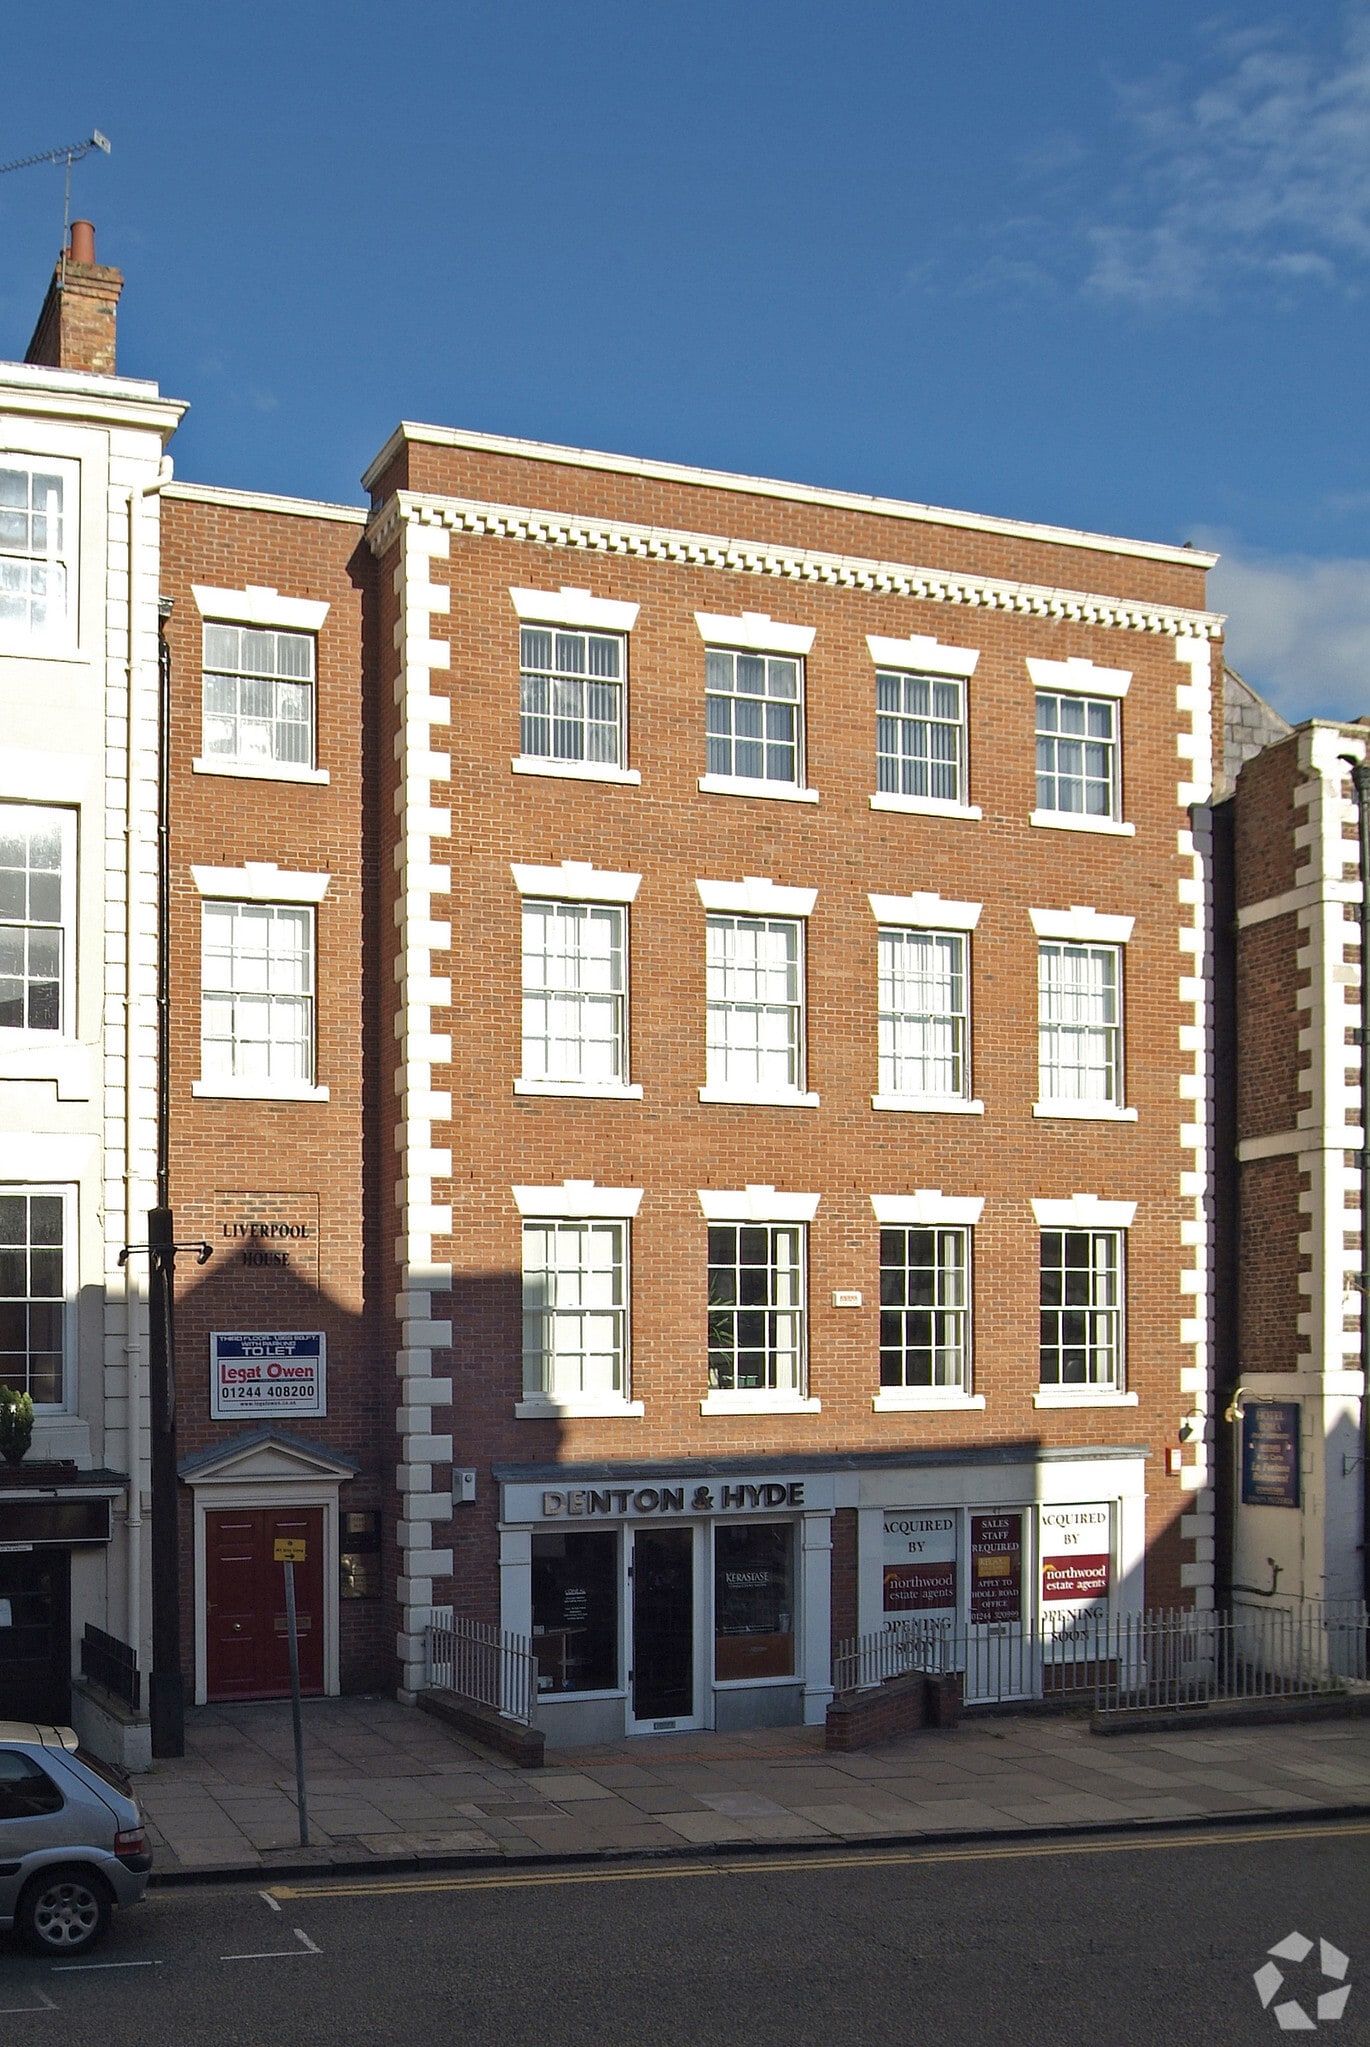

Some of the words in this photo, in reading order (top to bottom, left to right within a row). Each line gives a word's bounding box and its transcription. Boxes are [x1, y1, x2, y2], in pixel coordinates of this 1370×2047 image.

[223, 1224, 310, 1238] LIVERPOOL
[242, 1252, 290, 1266] HOUSE
[241, 1346, 264, 1356] TO
[266, 1346, 296, 1355] LET
[221, 1364, 261, 1384] Legat
[266, 1363, 314, 1378] Owen
[222, 1387, 262, 1398] 01244
[267, 1385, 315, 1397] 408200
[542, 1487, 686, 1516] DENTON
[692, 1485, 714, 1511] &
[721, 1482, 805, 1510] HYDE
[981, 1519, 1009, 1529] SALES
[981, 1531, 1009, 1540] STAFF
[1064, 1533, 1080, 1545] BY
[908, 1541, 925, 1553] BY
[971, 1542, 1019, 1553] REQUIRED
[1046, 1565, 1106, 1580] northwood
[890, 1573, 953, 1589] northwood
[1046, 1581, 1074, 1591] estate
[1077, 1580, 1107, 1592] agents
[889, 1590, 919, 1600] estate
[922, 1588, 954, 1600] agents
